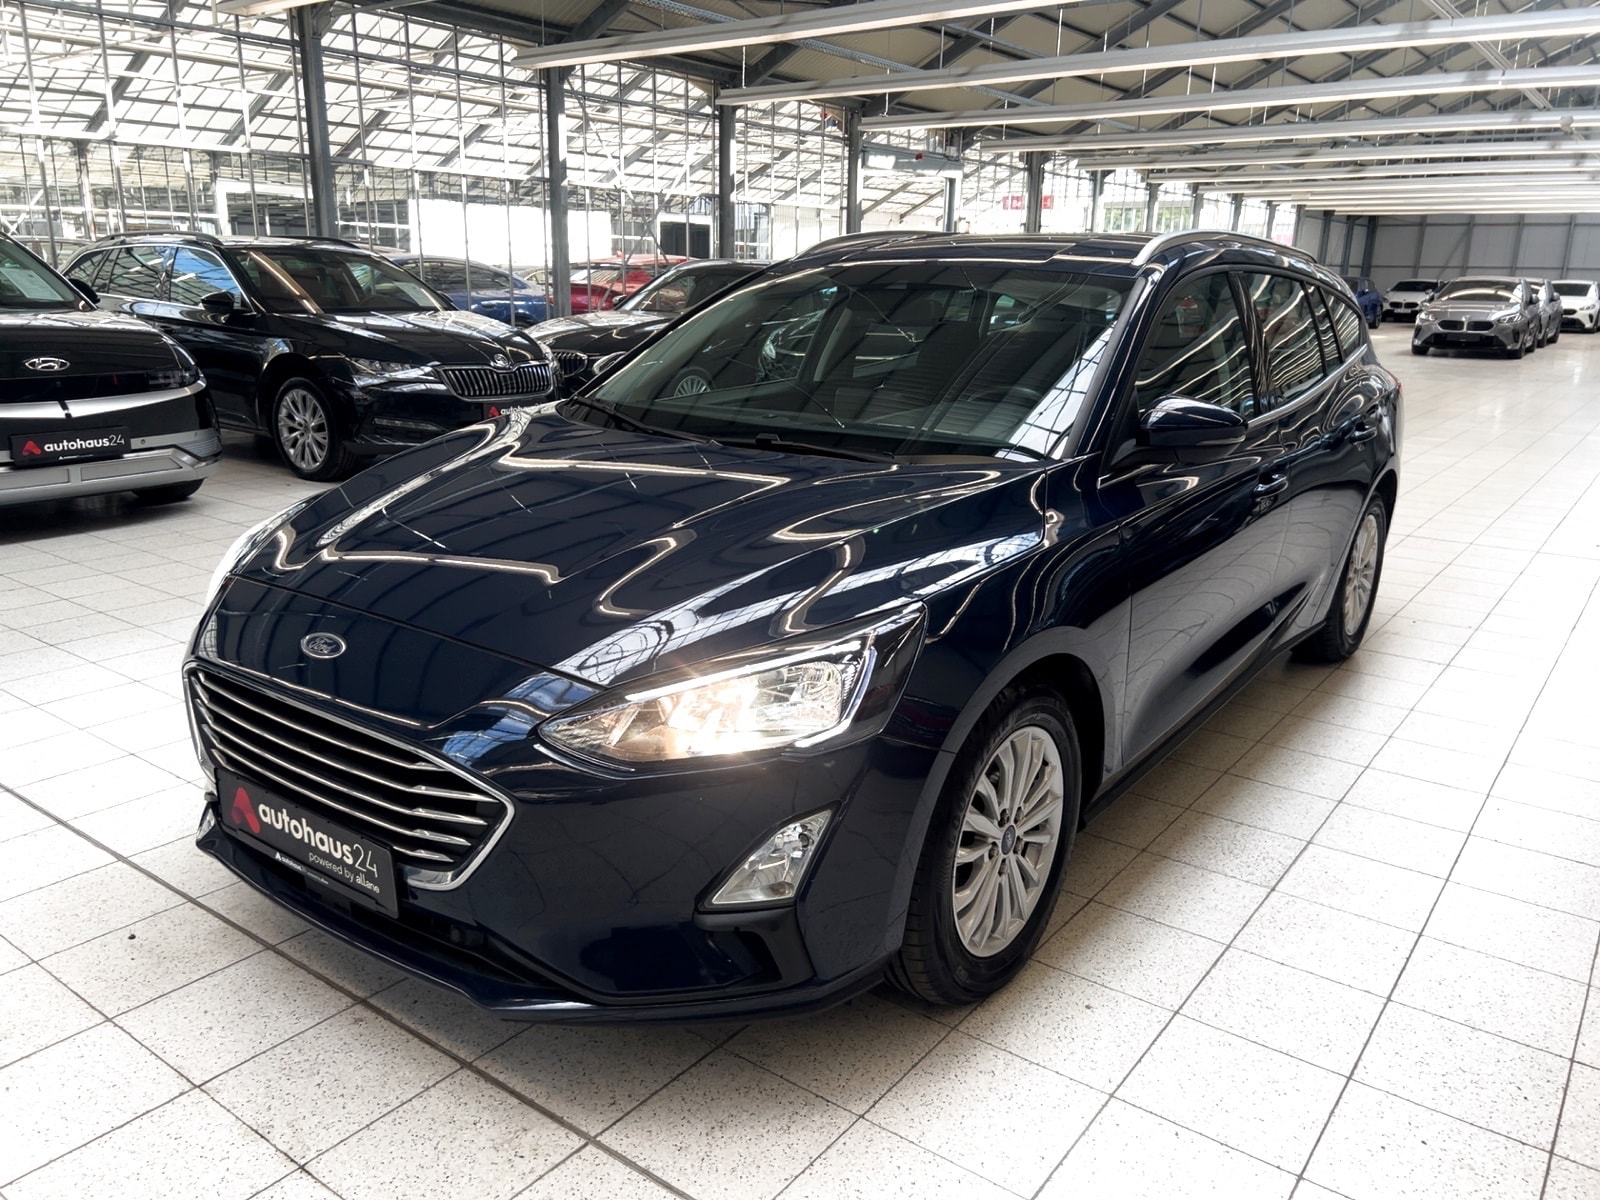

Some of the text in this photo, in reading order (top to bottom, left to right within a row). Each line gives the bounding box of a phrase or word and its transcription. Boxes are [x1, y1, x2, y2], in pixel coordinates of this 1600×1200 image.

[43, 434, 125, 452] autohaus24
[258, 803, 379, 878] autohaus24
[308, 852, 343, 875] powered
[344, 866, 355, 882] by
[355, 872, 380, 893] allane
